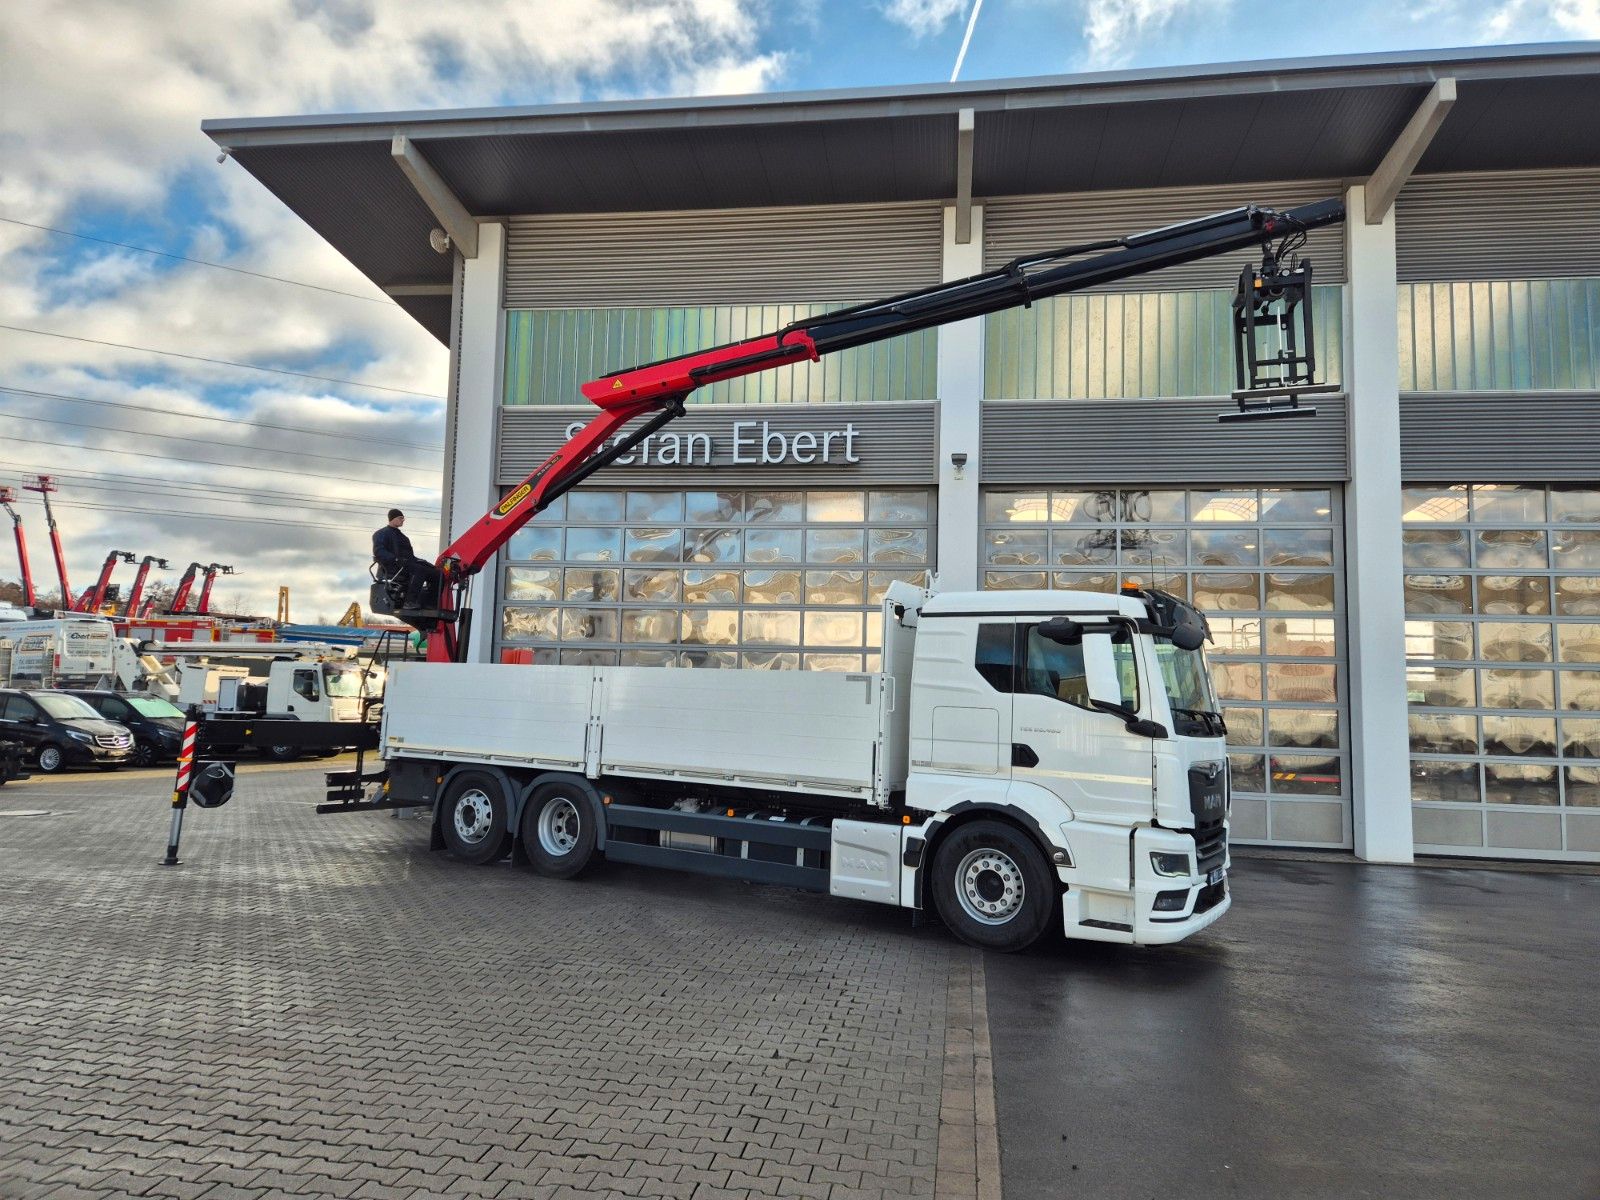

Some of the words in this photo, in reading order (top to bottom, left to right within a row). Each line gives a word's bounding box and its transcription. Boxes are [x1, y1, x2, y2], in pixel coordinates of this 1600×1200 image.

[565, 422, 712, 464] efan
[733, 421, 859, 464] Ebert
[500, 485, 530, 512] PALFINGER
[1203, 793, 1222, 809] MAN
[841, 855, 886, 872] MAN
